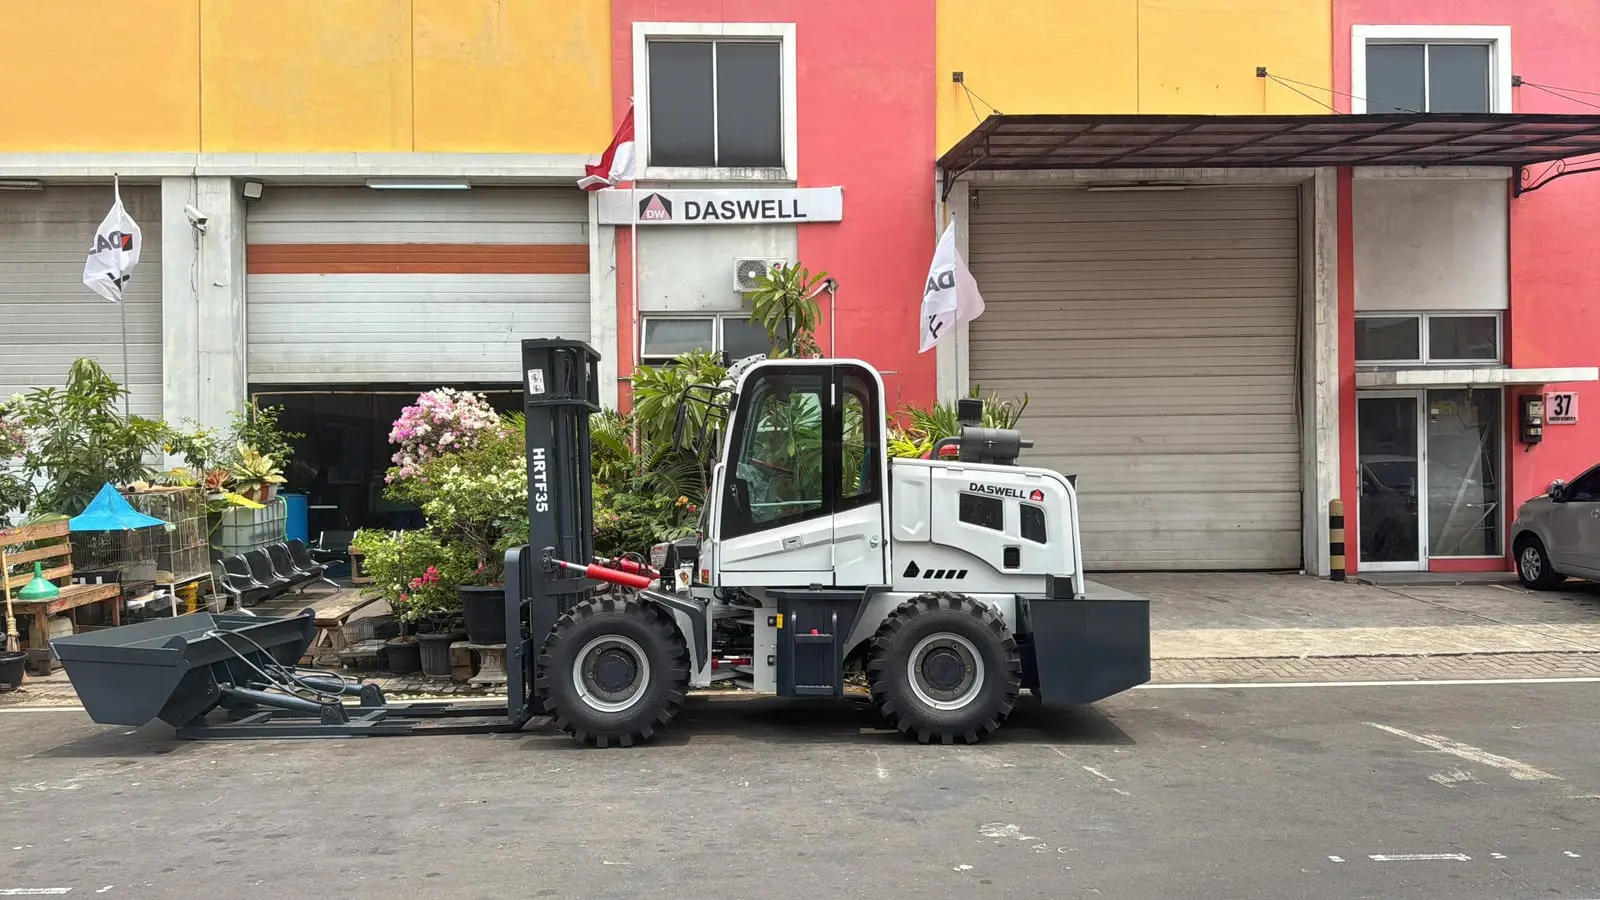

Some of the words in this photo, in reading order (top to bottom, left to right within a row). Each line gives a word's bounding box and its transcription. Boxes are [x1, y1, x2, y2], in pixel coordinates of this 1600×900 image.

[646, 209, 665, 219] DW
[685, 199, 807, 220] DASWELL
[1554, 394, 1572, 416] 37
[533, 447, 549, 513] HRTF35
[969, 482, 1026, 499] DASWELL
